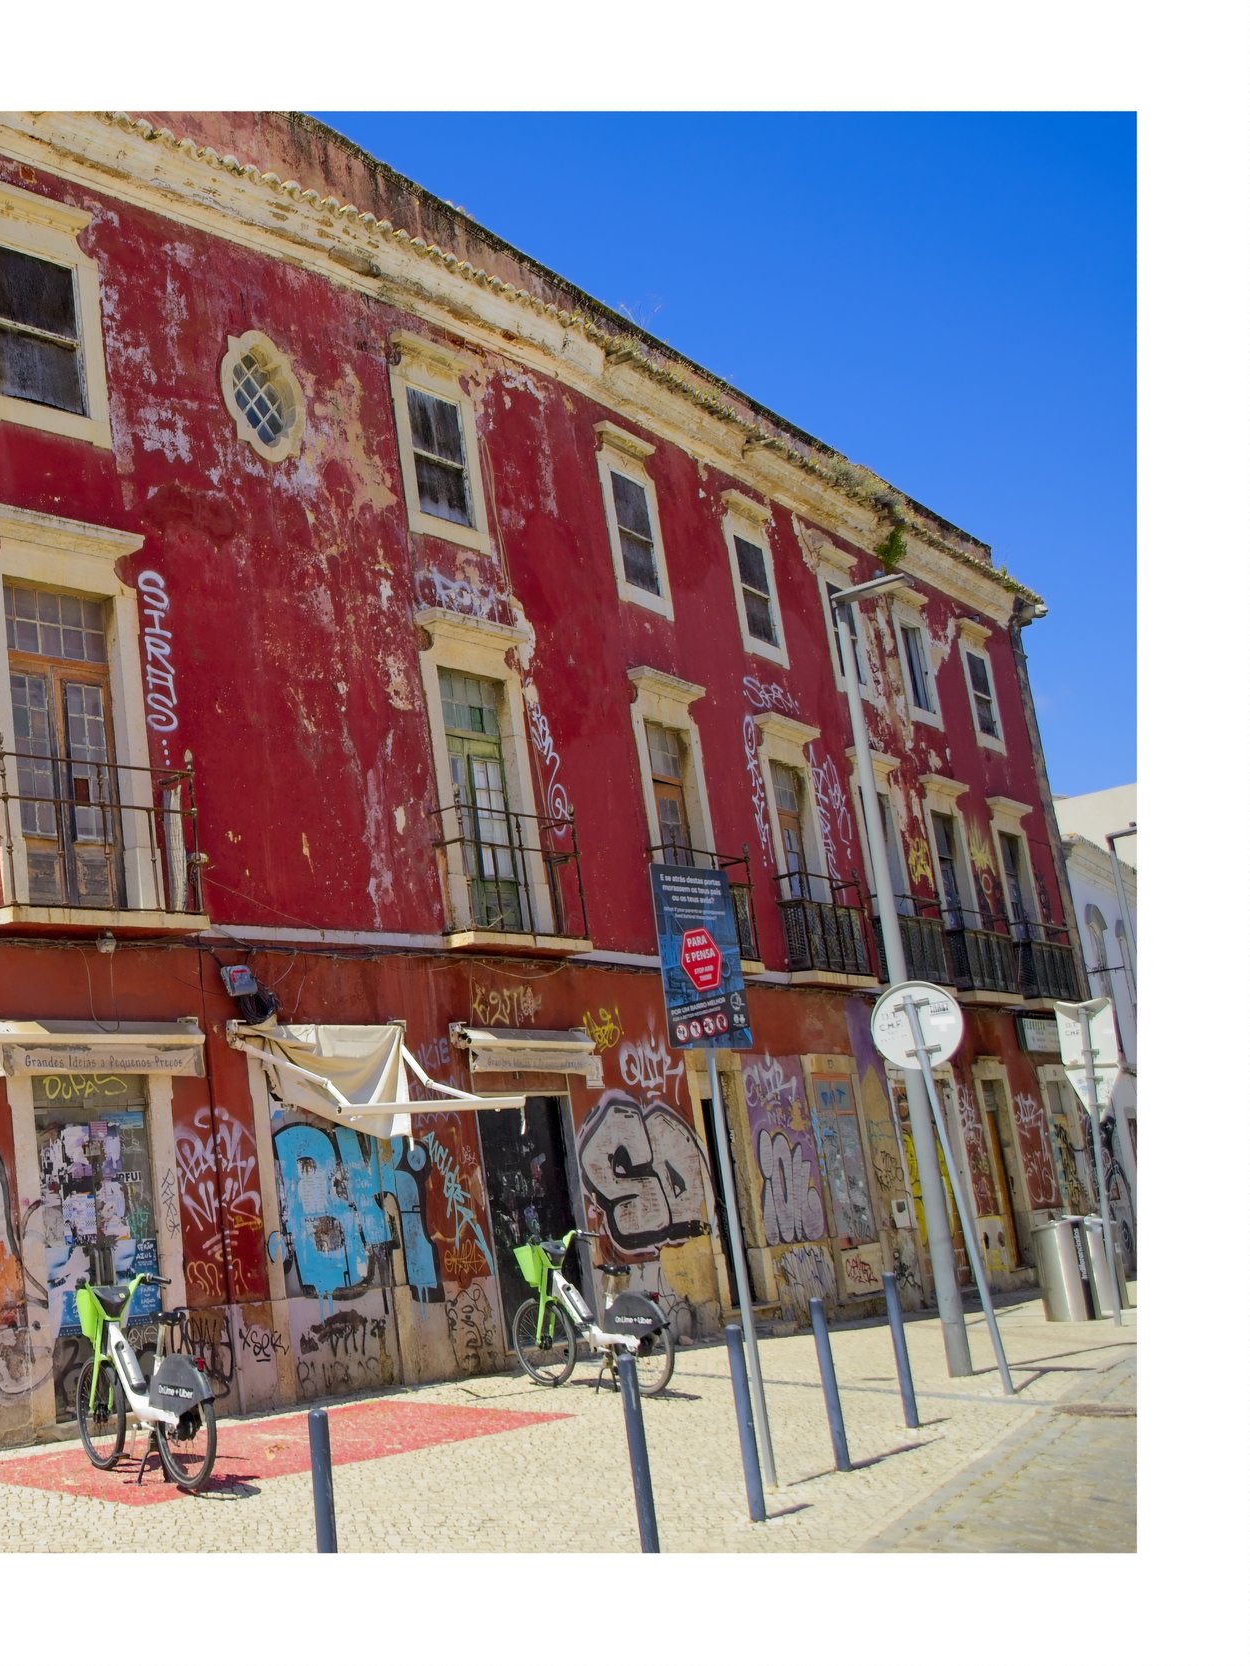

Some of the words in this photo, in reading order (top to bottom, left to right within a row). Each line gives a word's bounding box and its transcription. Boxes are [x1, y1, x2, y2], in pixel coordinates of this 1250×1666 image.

[686, 875, 703, 884] destas
[662, 885, 690, 893] morassem
[686, 935, 707, 948] PARA
[685, 953, 691, 963] E
[691, 948, 716, 962] PENSA
[671, 1008, 681, 1016] POR
[681, 1006, 690, 1014] UM
[690, 1001, 707, 1011] BAIRRO
[25, 1054, 64, 1069] Grandes
[68, 1055, 96, 1068] Ideias
[109, 1055, 151, 1071] Pequenos
